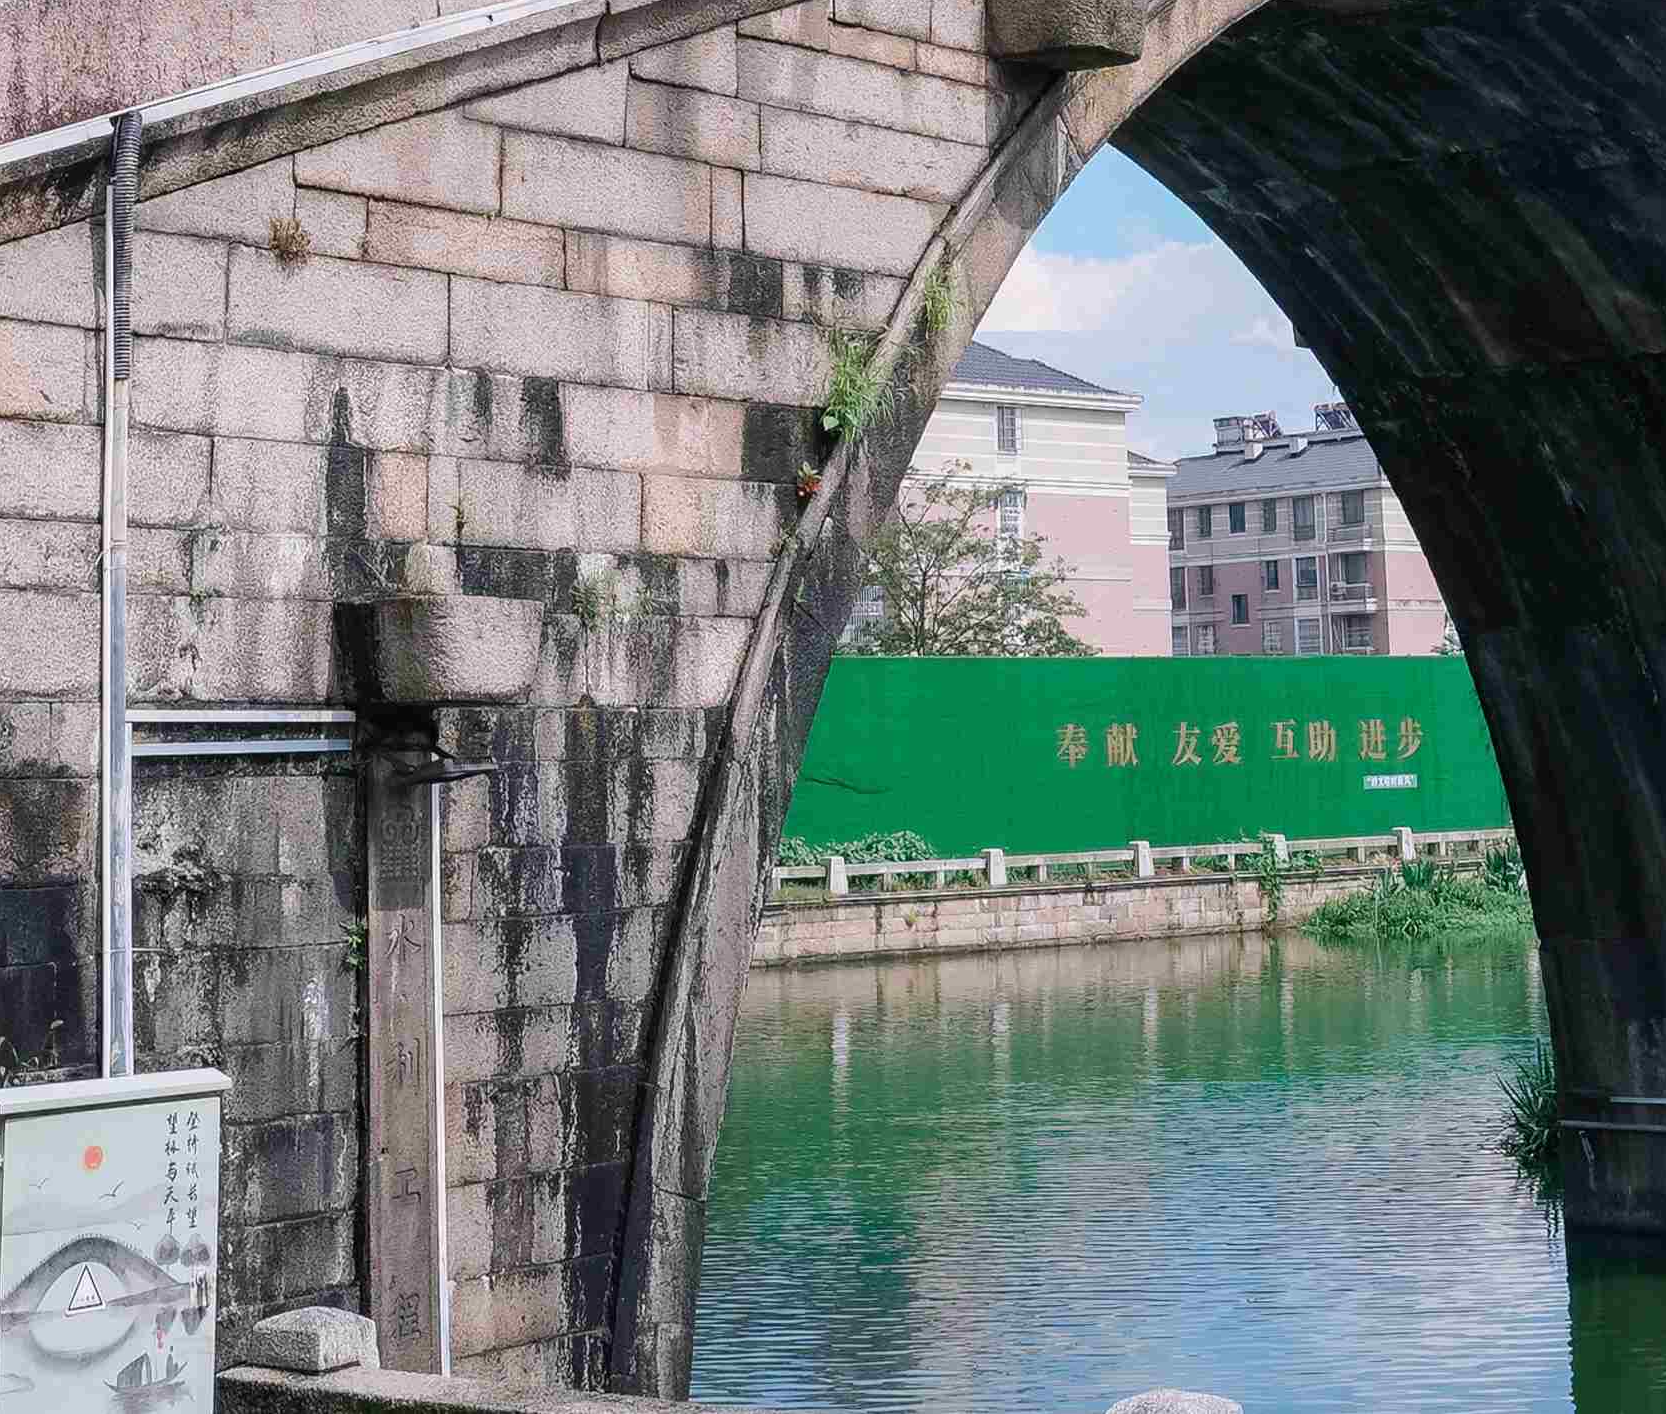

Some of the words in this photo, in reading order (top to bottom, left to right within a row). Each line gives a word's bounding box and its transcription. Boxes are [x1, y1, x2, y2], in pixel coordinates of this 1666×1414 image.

[1056, 722, 1139, 768] 奉献
[1172, 722, 1243, 766] 友爱
[1270, 719, 1337, 762] 互助
[1358, 718, 1424, 761] 进步
